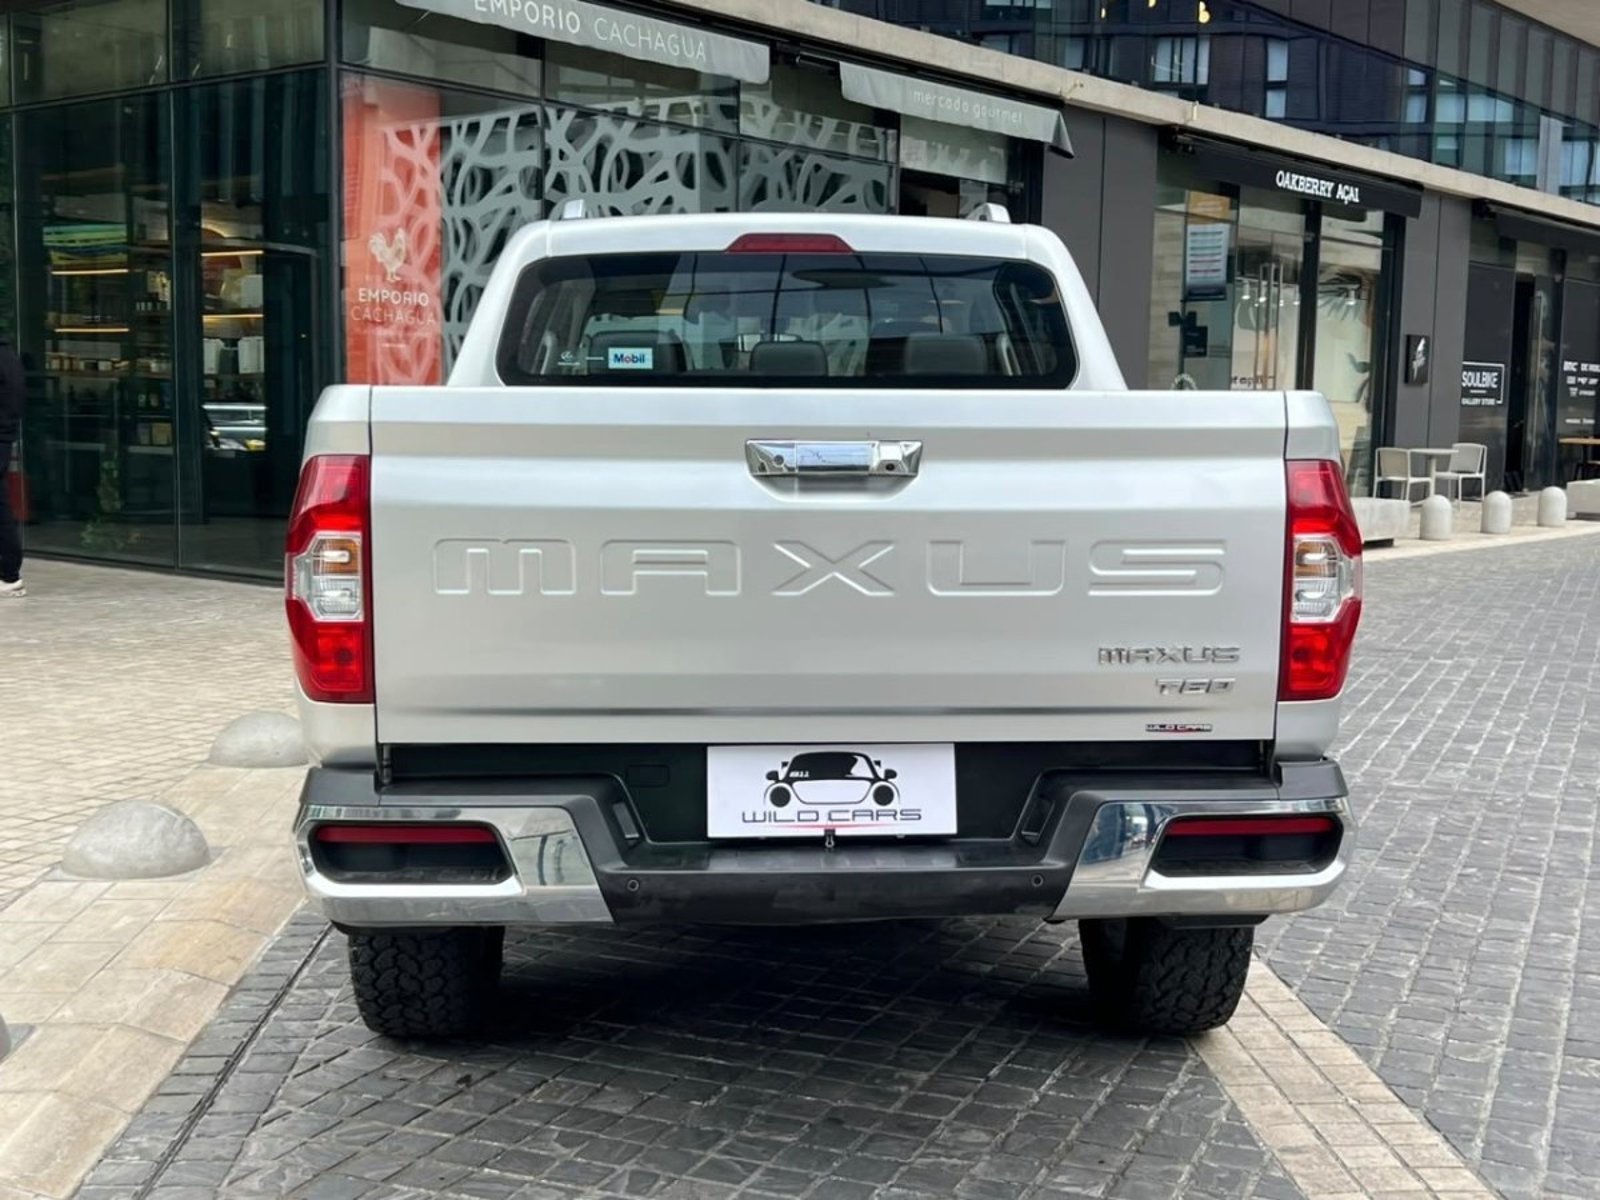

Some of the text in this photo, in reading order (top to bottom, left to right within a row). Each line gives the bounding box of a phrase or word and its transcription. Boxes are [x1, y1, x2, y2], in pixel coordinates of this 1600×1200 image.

[474, 0, 707, 62] EMPORIO CACHAGUA
[913, 91, 1022, 123] mercado gourmet
[1275, 170, 1335, 198] OAKBERRY
[358, 287, 429, 307] EMPORIO
[351, 305, 436, 326] CACHAGUA
[613, 353, 645, 364] Mobil
[433, 538, 1226, 597] MAXUS
[1098, 647, 1240, 664] MAXUS
[741, 808, 922, 823] WILD CARS
